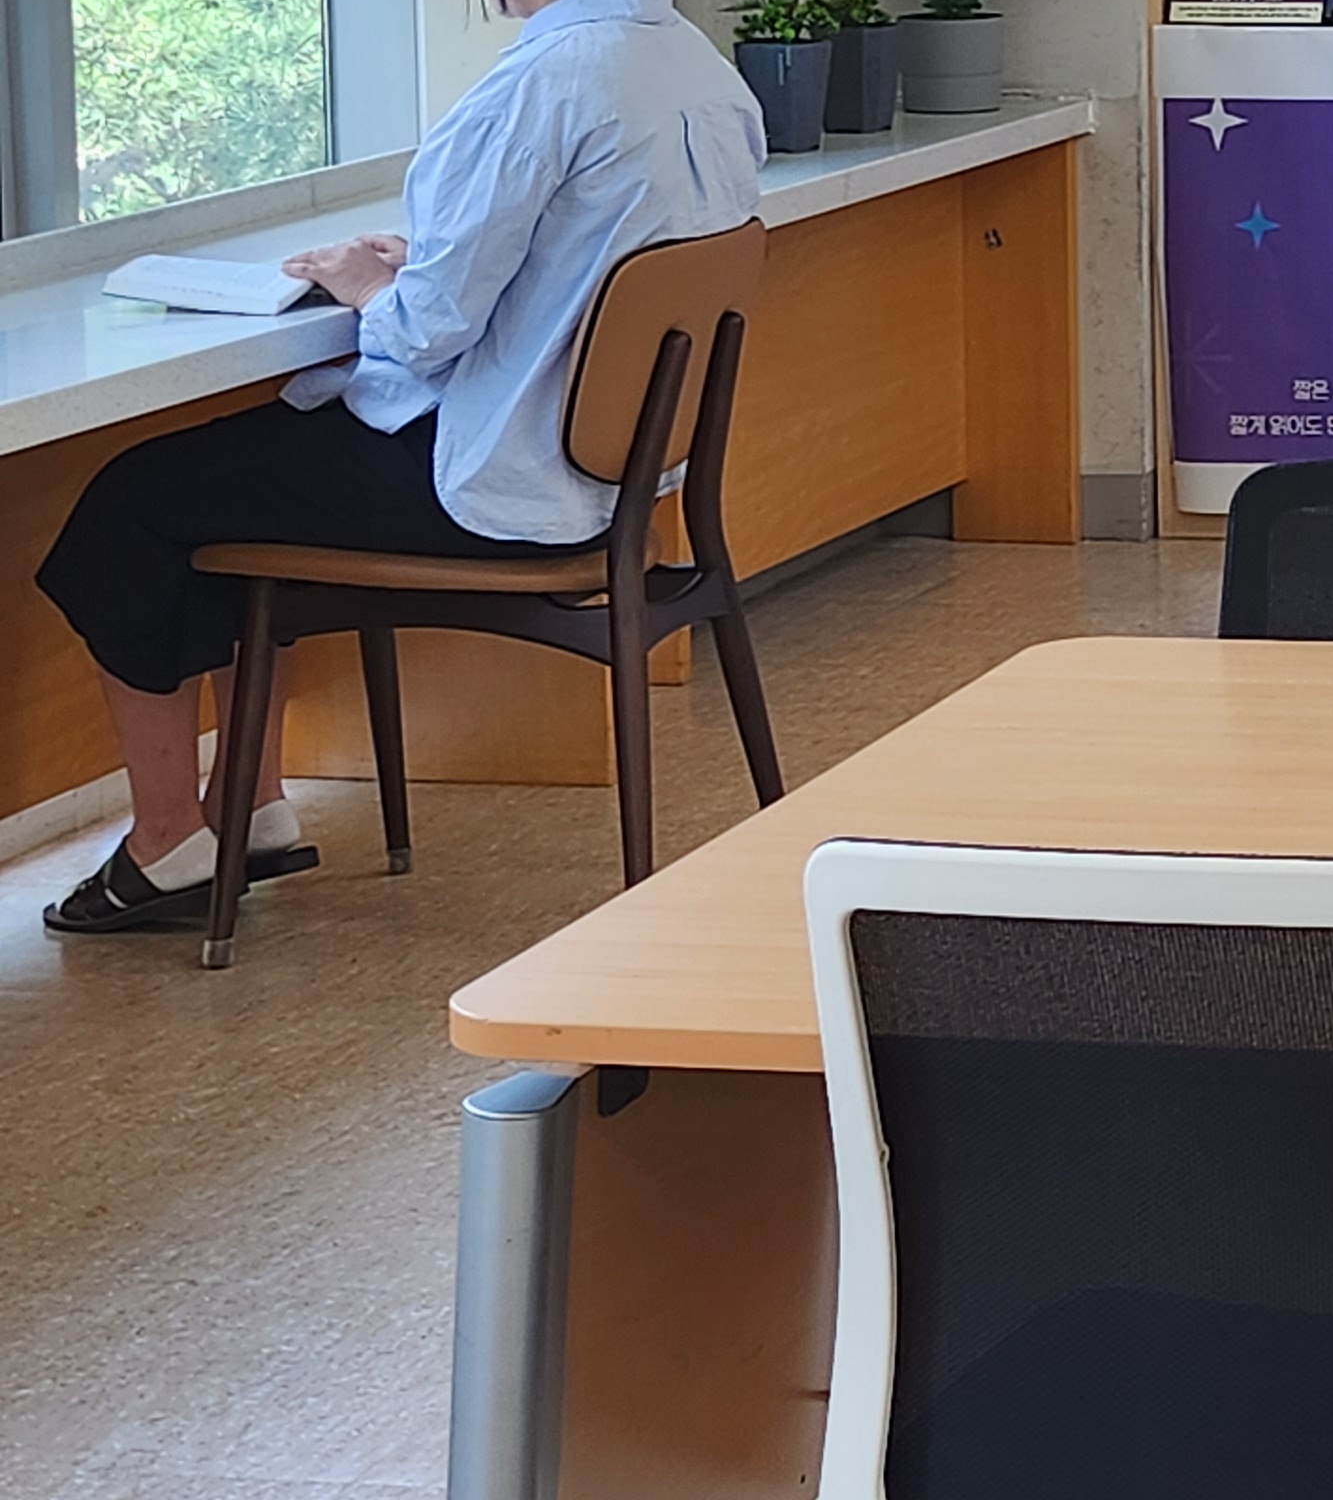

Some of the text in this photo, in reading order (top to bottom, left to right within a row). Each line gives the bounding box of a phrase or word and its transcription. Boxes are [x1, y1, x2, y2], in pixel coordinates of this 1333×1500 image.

[1292, 378, 1331, 402] 짧은
[1228, 413, 1267, 437] 짧게
[1268, 414, 1325, 437] 읽어도
